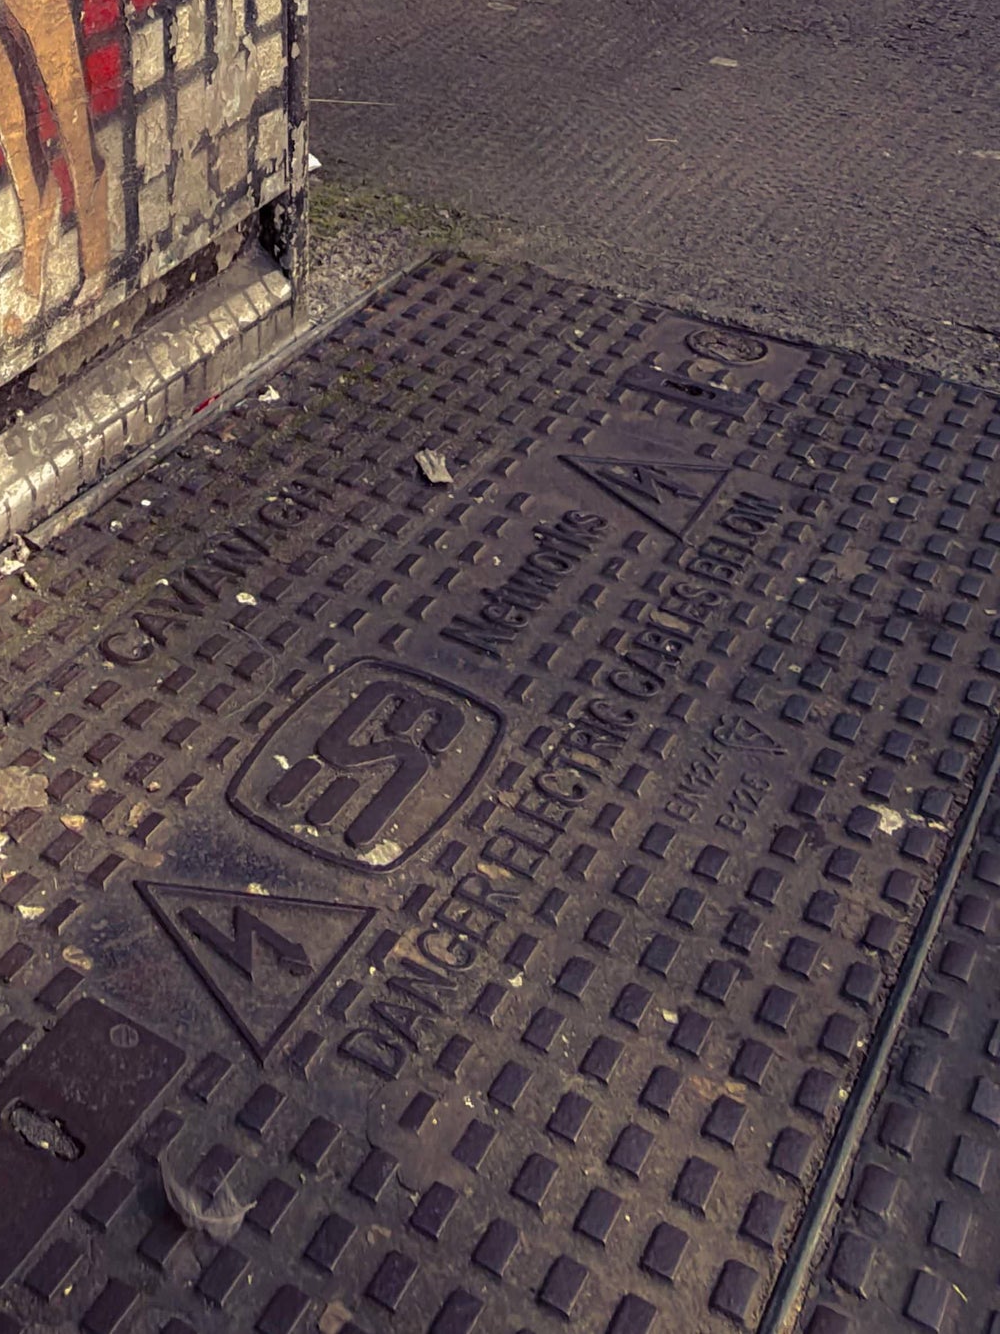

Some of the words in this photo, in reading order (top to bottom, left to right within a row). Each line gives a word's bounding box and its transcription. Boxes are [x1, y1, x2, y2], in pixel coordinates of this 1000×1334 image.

[336, 871, 518, 1074] DANGER
[482, 696, 641, 868] ELECTRIC
[610, 578, 726, 700] CABLES
[683, 490, 784, 580] BELOW
